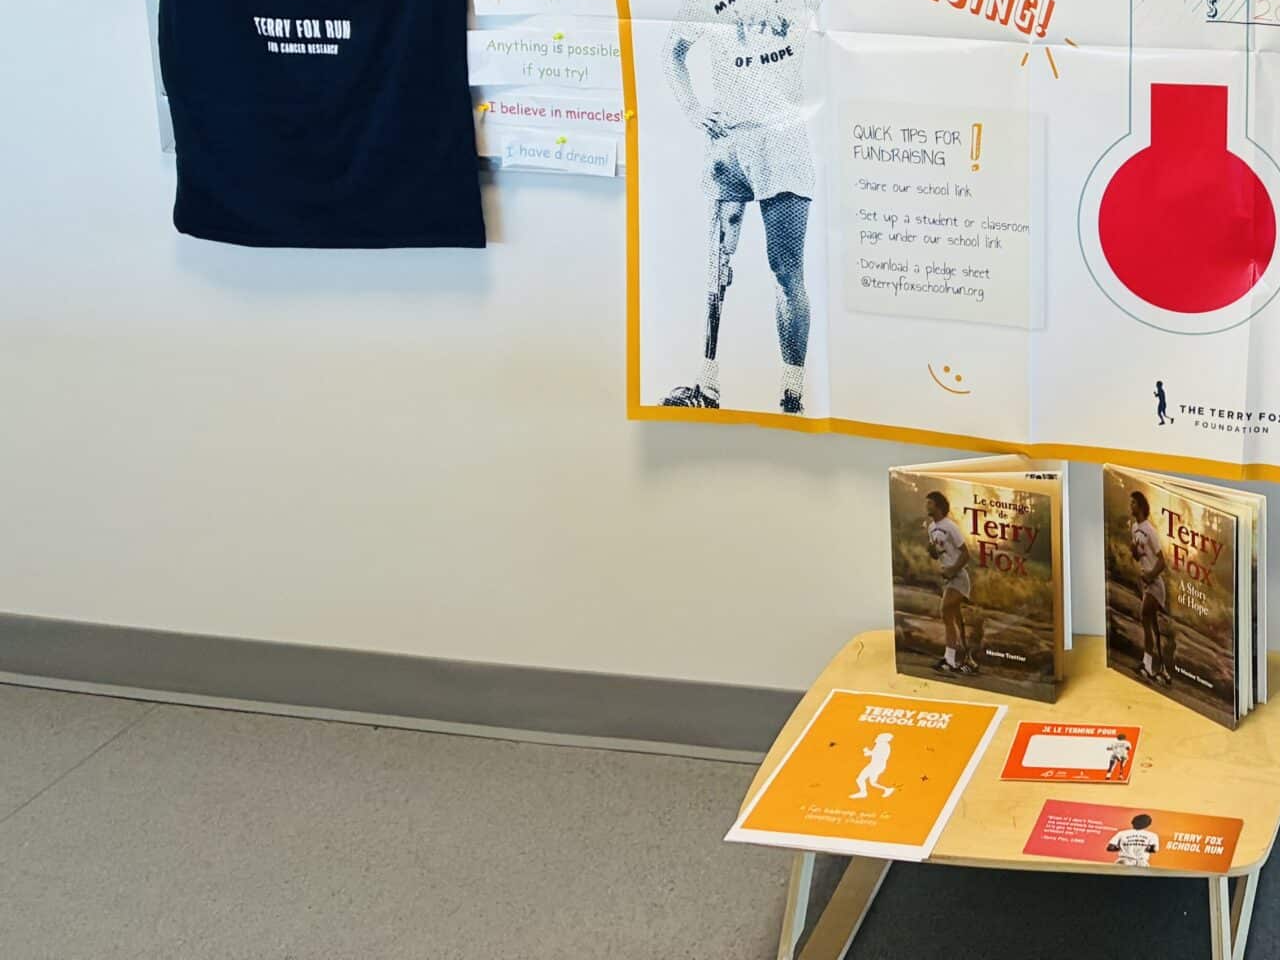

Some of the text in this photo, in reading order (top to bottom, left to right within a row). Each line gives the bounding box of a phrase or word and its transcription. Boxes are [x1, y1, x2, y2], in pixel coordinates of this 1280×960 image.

[253, 16, 351, 39] TERRY FOX RUN
[485, 39, 620, 58] Anything is possible
[734, 44, 795, 69] OF HOPE
[522, 62, 589, 82] if you try!
[488, 101, 624, 123] I believe in miracles!
[852, 124, 962, 146] QUICK TIPS FOR
[853, 145, 946, 166] FUNDRAISING
[892, 184, 911, 193] our
[916, 181, 950, 196] school
[954, 183, 973, 198] link
[860, 258, 990, 281] Download a pledge sheet
[861, 275, 985, 303] @terryfoxschoolrun.org
[1179, 404, 1205, 416] THE
[1208, 408, 1253, 421] TERRY
[1194, 420, 1269, 434] FOUNDATION
[973, 494, 1030, 515] Le courage
[999, 510, 1008, 519] de
[963, 507, 1040, 554] Terry
[1162, 507, 1223, 565] Terry
[1179, 579, 1206, 603] A Story
[1178, 594, 1209, 617] of Hope
[859, 715, 950, 729] SCHOOL RUN
[864, 705, 952, 722] TERRY FOX
[1064, 727, 1095, 735] TERMINE
[1166, 842, 1224, 855] SCHOOL RUN
[1173, 832, 1224, 846] TERRY FOX
